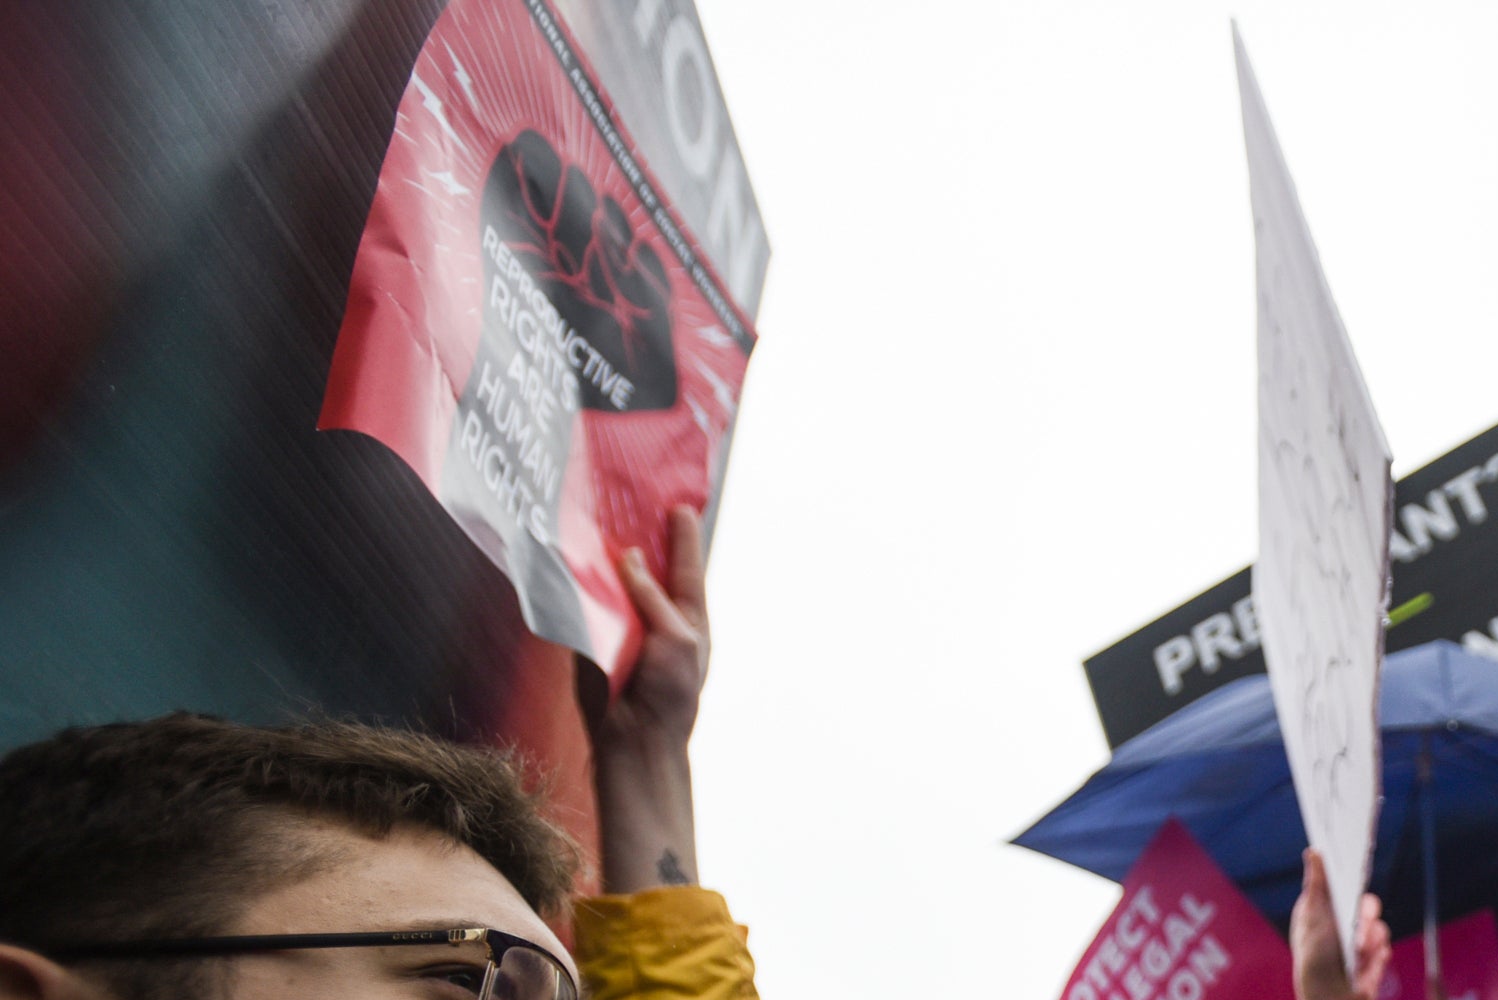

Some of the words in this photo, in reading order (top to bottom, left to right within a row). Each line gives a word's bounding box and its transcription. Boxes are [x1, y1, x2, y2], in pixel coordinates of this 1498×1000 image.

[569, 66, 642, 190] ASSOCIATION
[482, 224, 636, 411] REPRODUCTIVE
[490, 274, 579, 413] RIGHTS
[476, 359, 558, 502] HUMAN
[507, 350, 554, 434] ARE
[460, 408, 550, 548] RIGHTS
